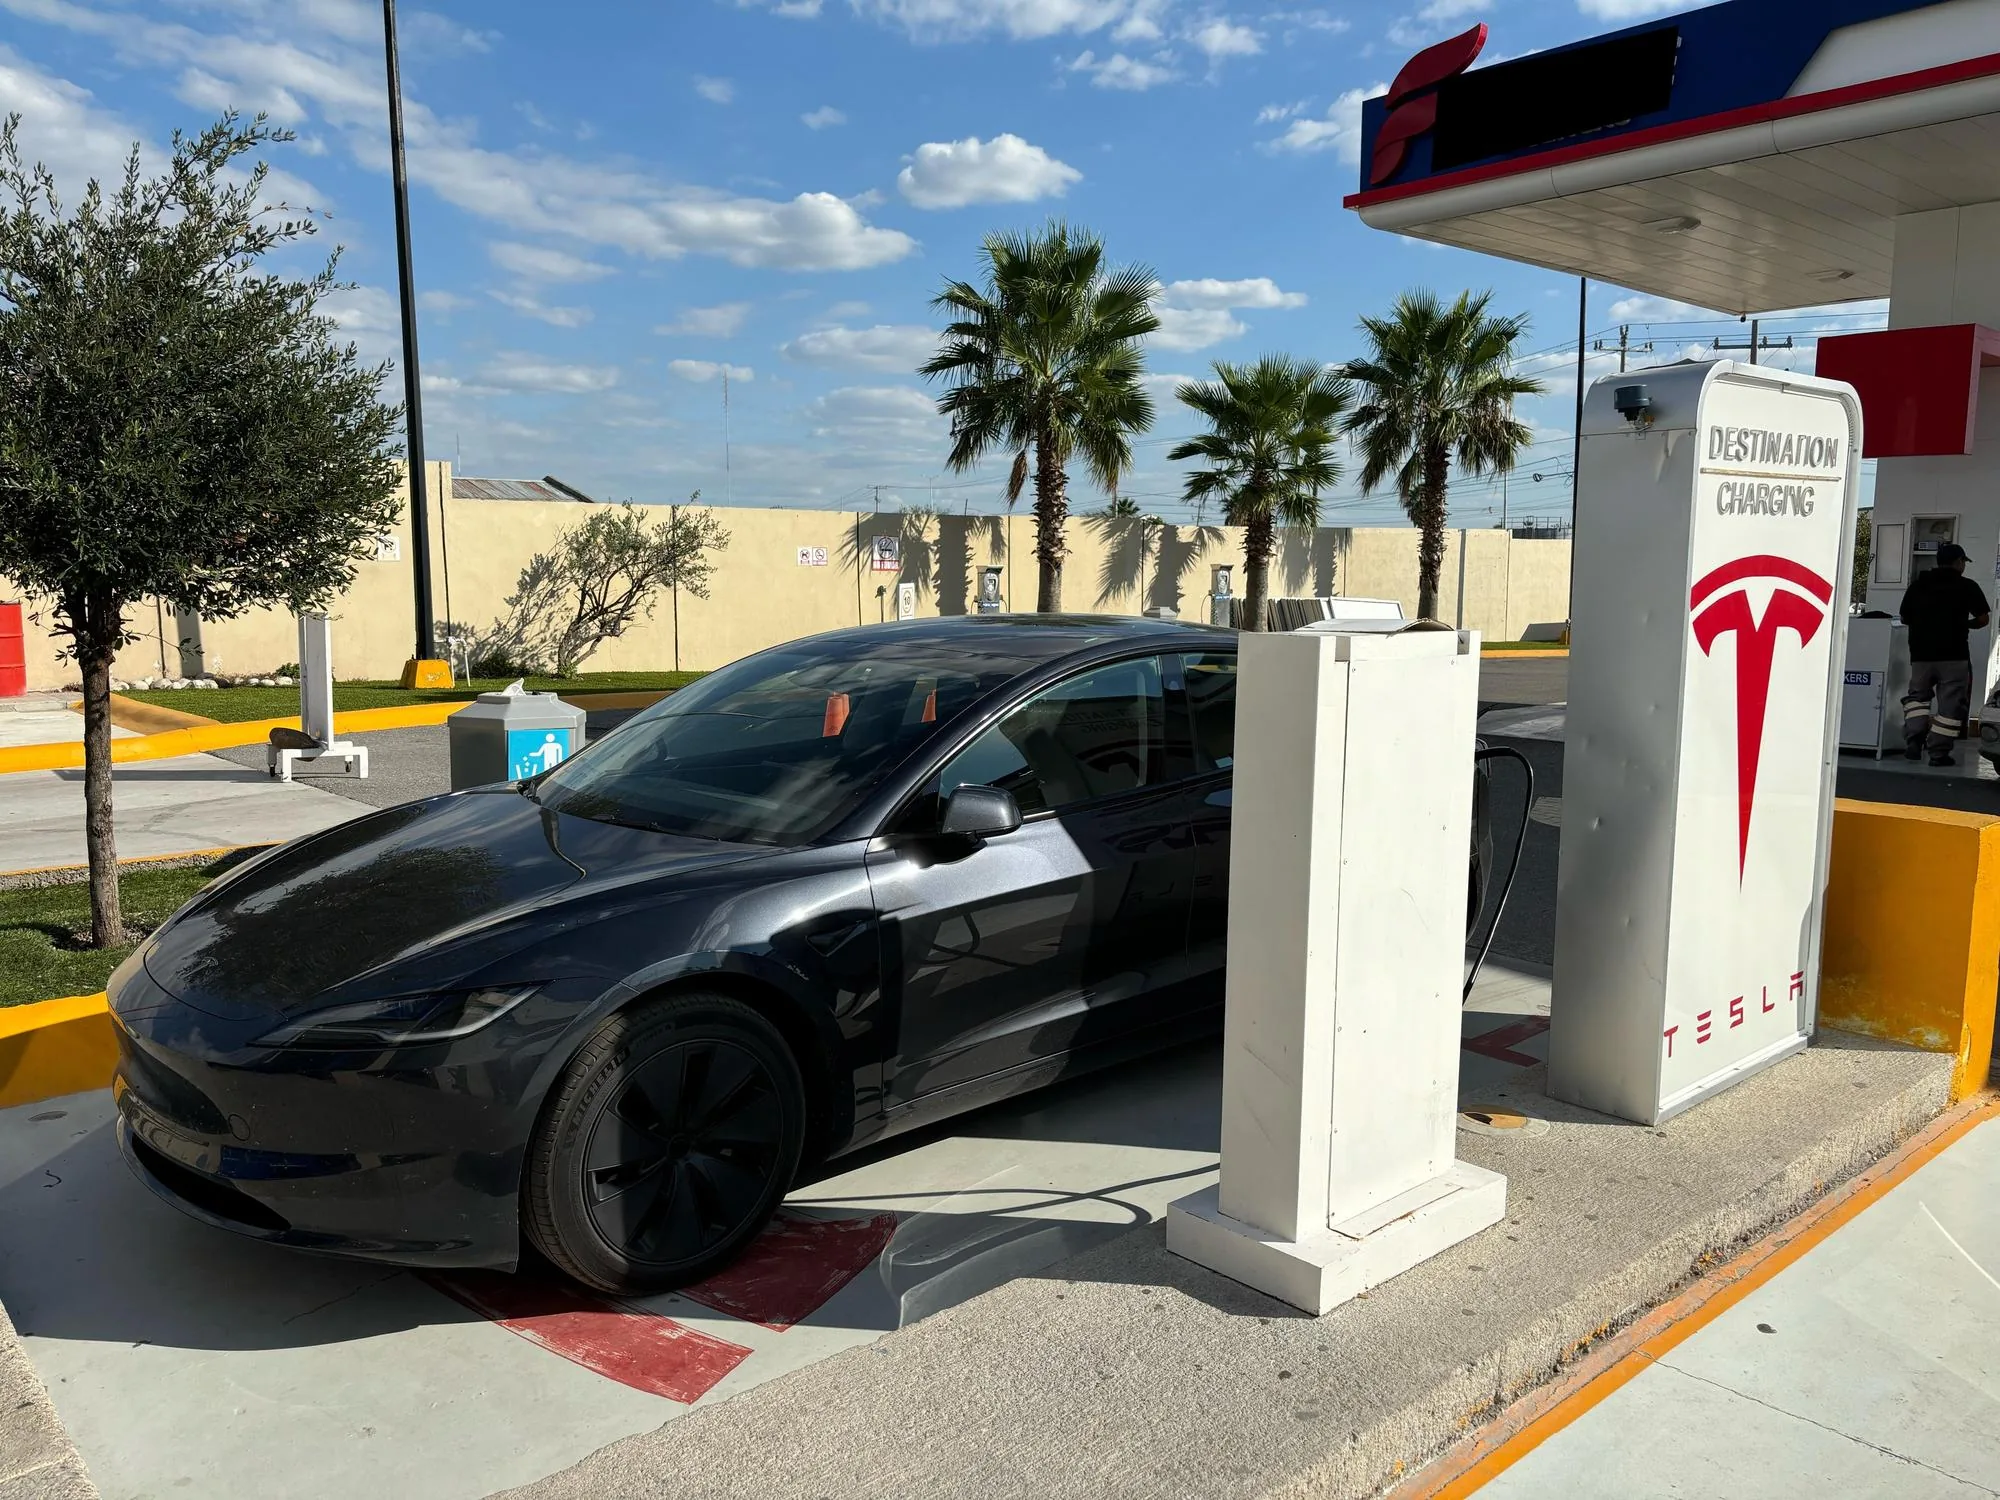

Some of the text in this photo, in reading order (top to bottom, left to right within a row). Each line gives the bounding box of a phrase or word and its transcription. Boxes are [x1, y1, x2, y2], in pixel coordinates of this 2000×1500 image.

[1709, 425, 1839, 469] DESTINATION
[1717, 481, 1815, 517] CHARGING
[1664, 971, 1804, 1058] TESLA
